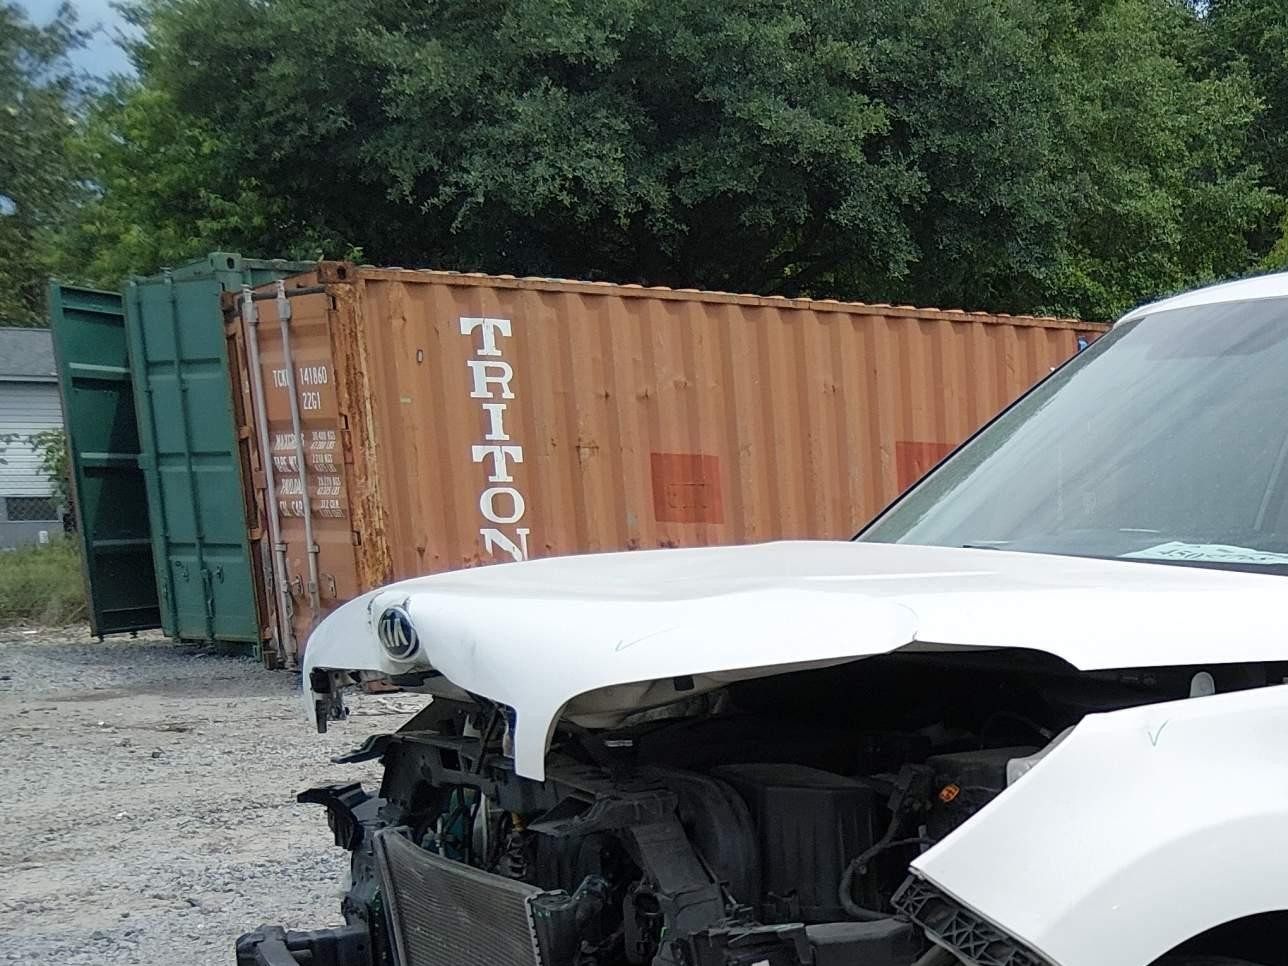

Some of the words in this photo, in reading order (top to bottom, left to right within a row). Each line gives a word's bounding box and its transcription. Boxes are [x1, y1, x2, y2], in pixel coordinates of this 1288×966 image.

[299, 366, 328, 385] 141860
[459, 317, 530, 561] TRITON
[380, 618, 409, 648] KIA
